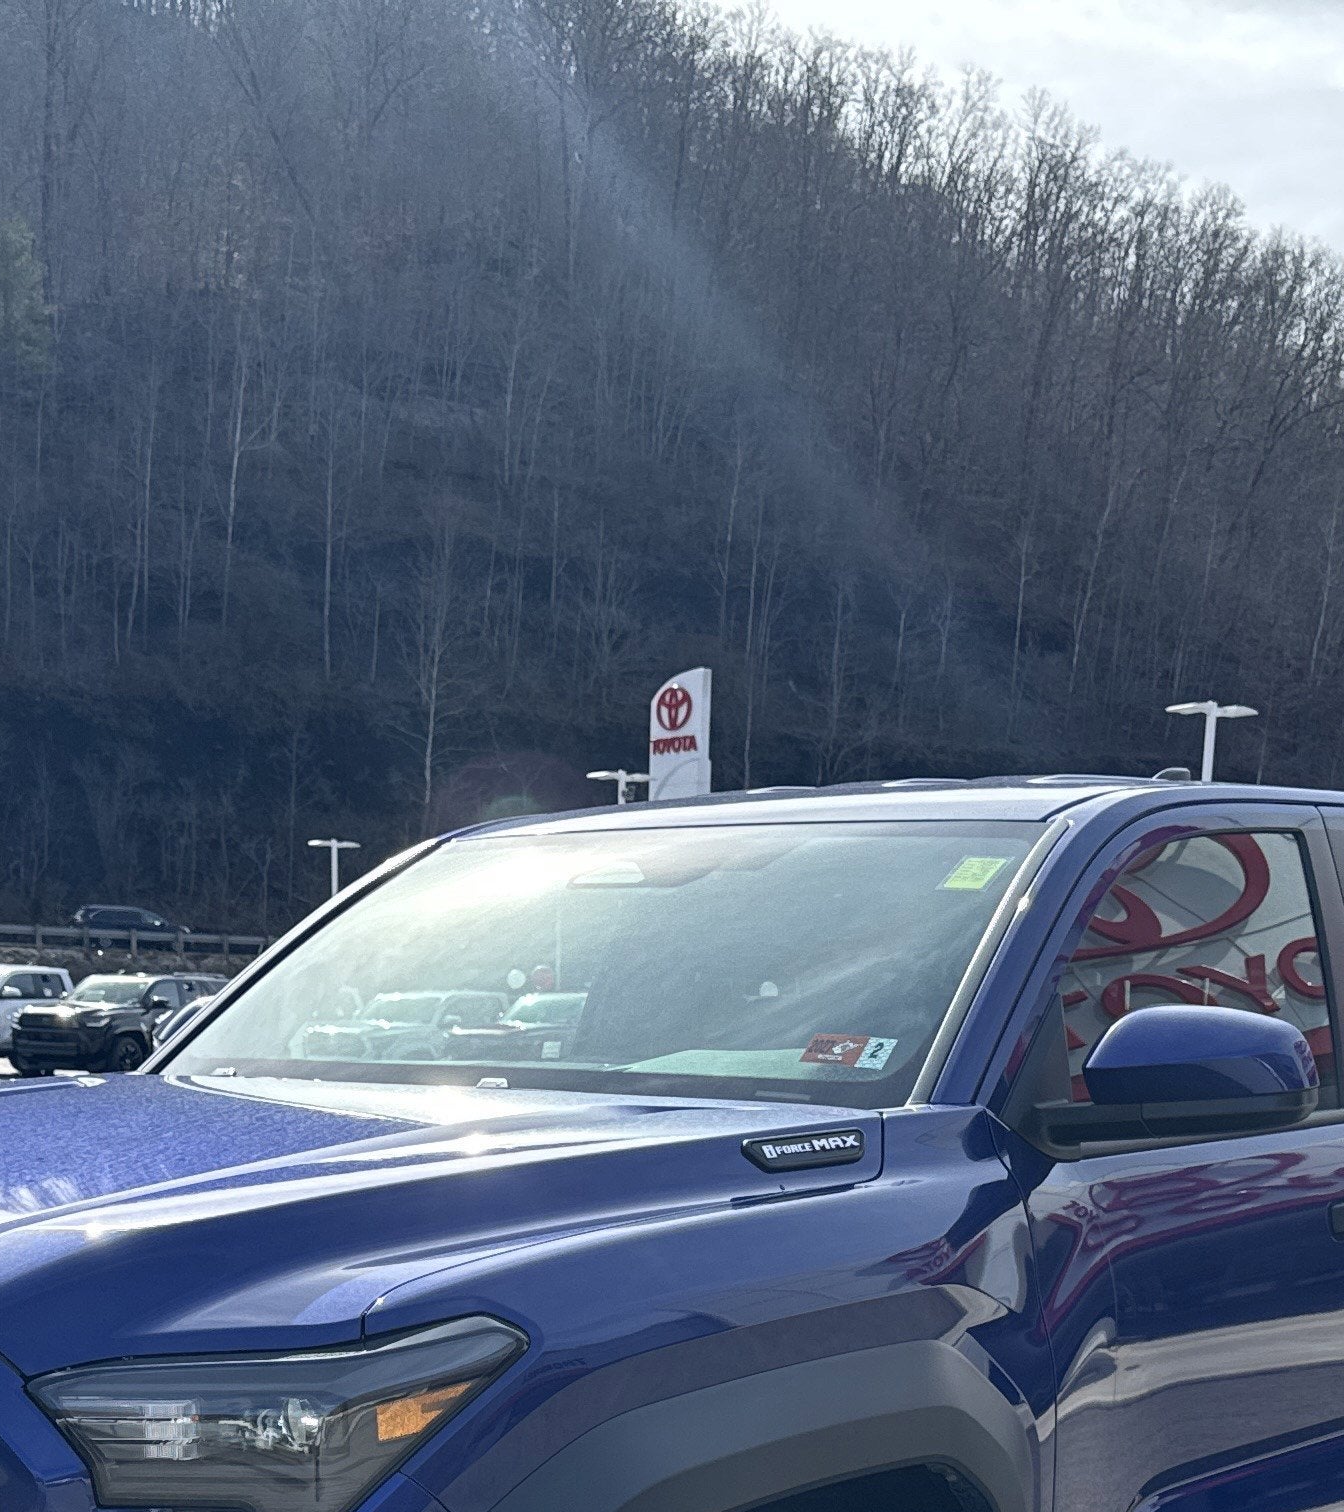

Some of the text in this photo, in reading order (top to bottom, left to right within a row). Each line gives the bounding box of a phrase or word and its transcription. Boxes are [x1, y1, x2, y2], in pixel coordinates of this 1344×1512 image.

[650, 735, 697, 756] TOYOTA
[869, 1042, 884, 1058] 2
[811, 1135, 860, 1151] MAX
